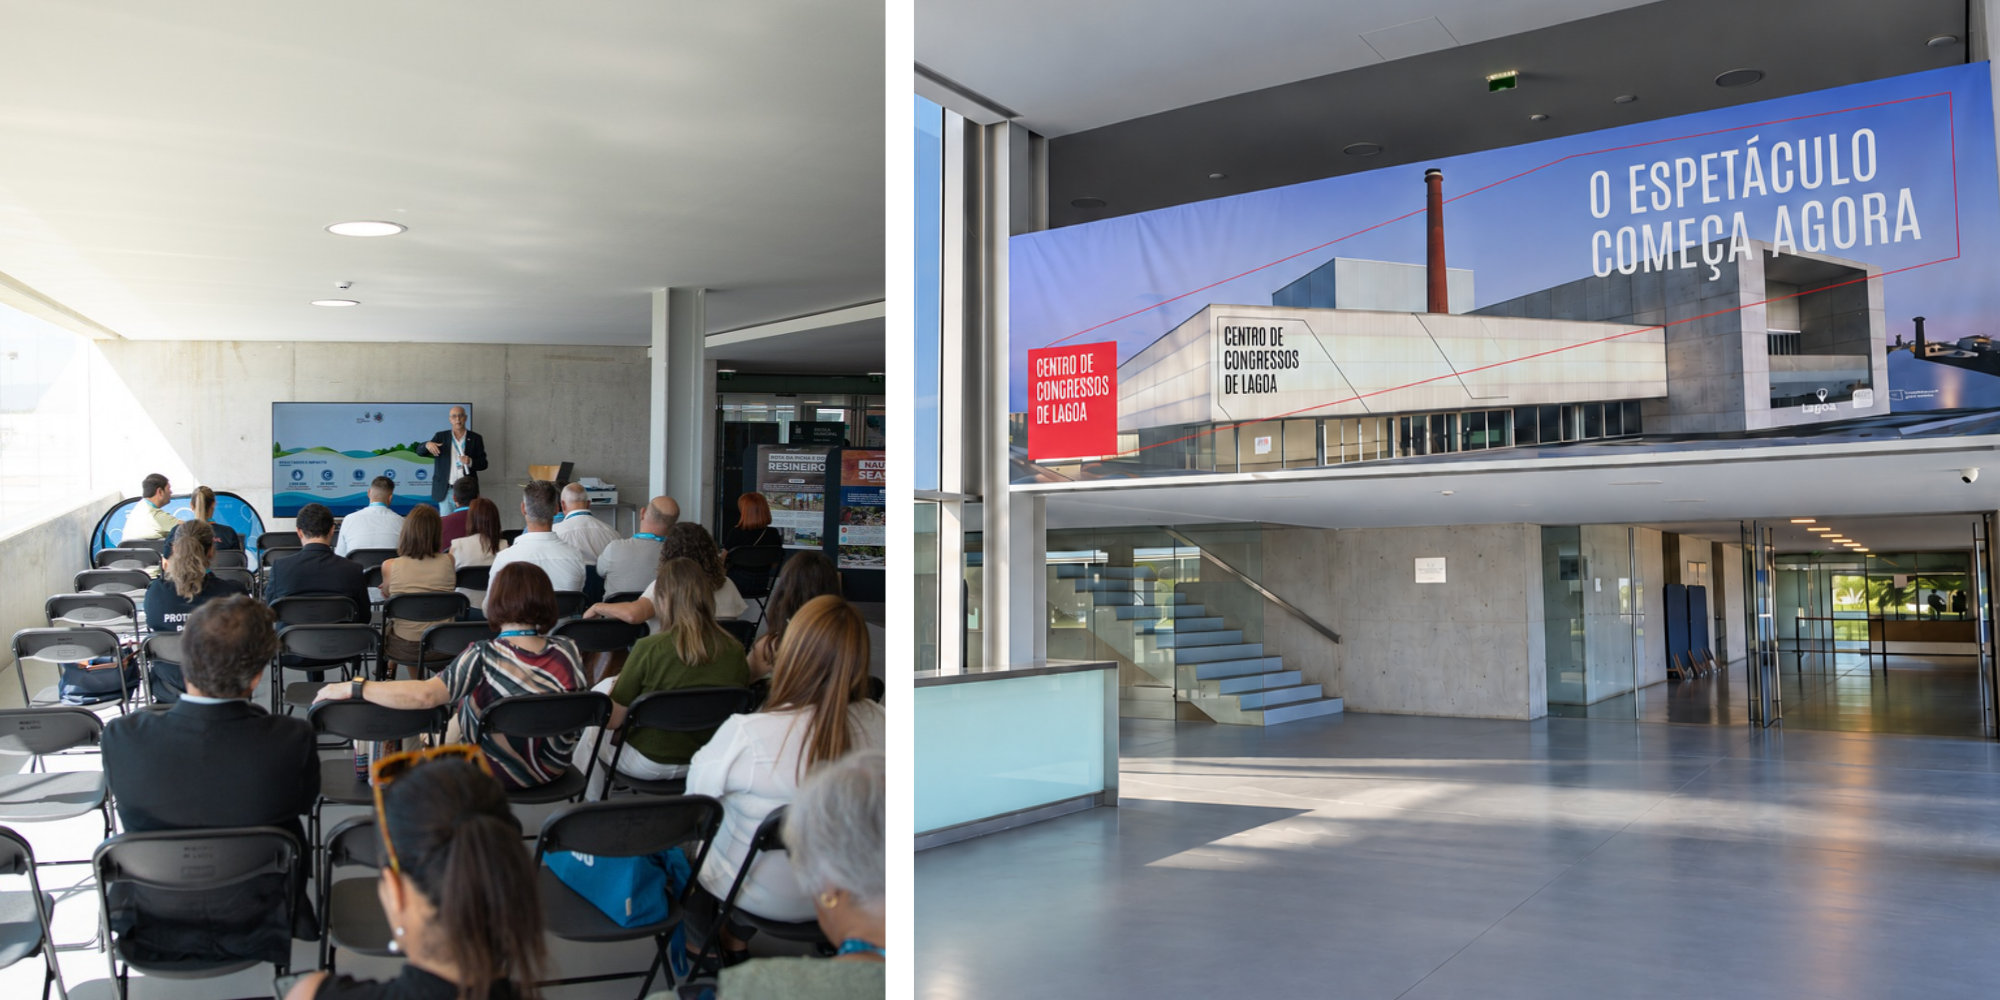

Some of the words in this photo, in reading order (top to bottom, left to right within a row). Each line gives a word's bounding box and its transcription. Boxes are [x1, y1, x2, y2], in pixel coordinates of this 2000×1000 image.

[1590, 170, 1611, 219] O
[1629, 128, 1877, 214] ESPETÁCULO
[1592, 211, 1753, 281] COMEÇA
[1772, 187, 1922, 258] AGORA
[1224, 326, 1266, 346] CENTRO
[1269, 326, 1284, 347] DE
[1036, 355, 1077, 378] CENTRO
[1080, 353, 1094, 374] DE
[1224, 349, 1300, 370] CONGRESSOS
[1036, 375, 1109, 402] CONGRESSOS
[1225, 373, 1238, 394] DE
[1242, 373, 1277, 394] LAGOA
[1036, 404, 1050, 425] DE
[1052, 402, 1087, 424] LAGOA
